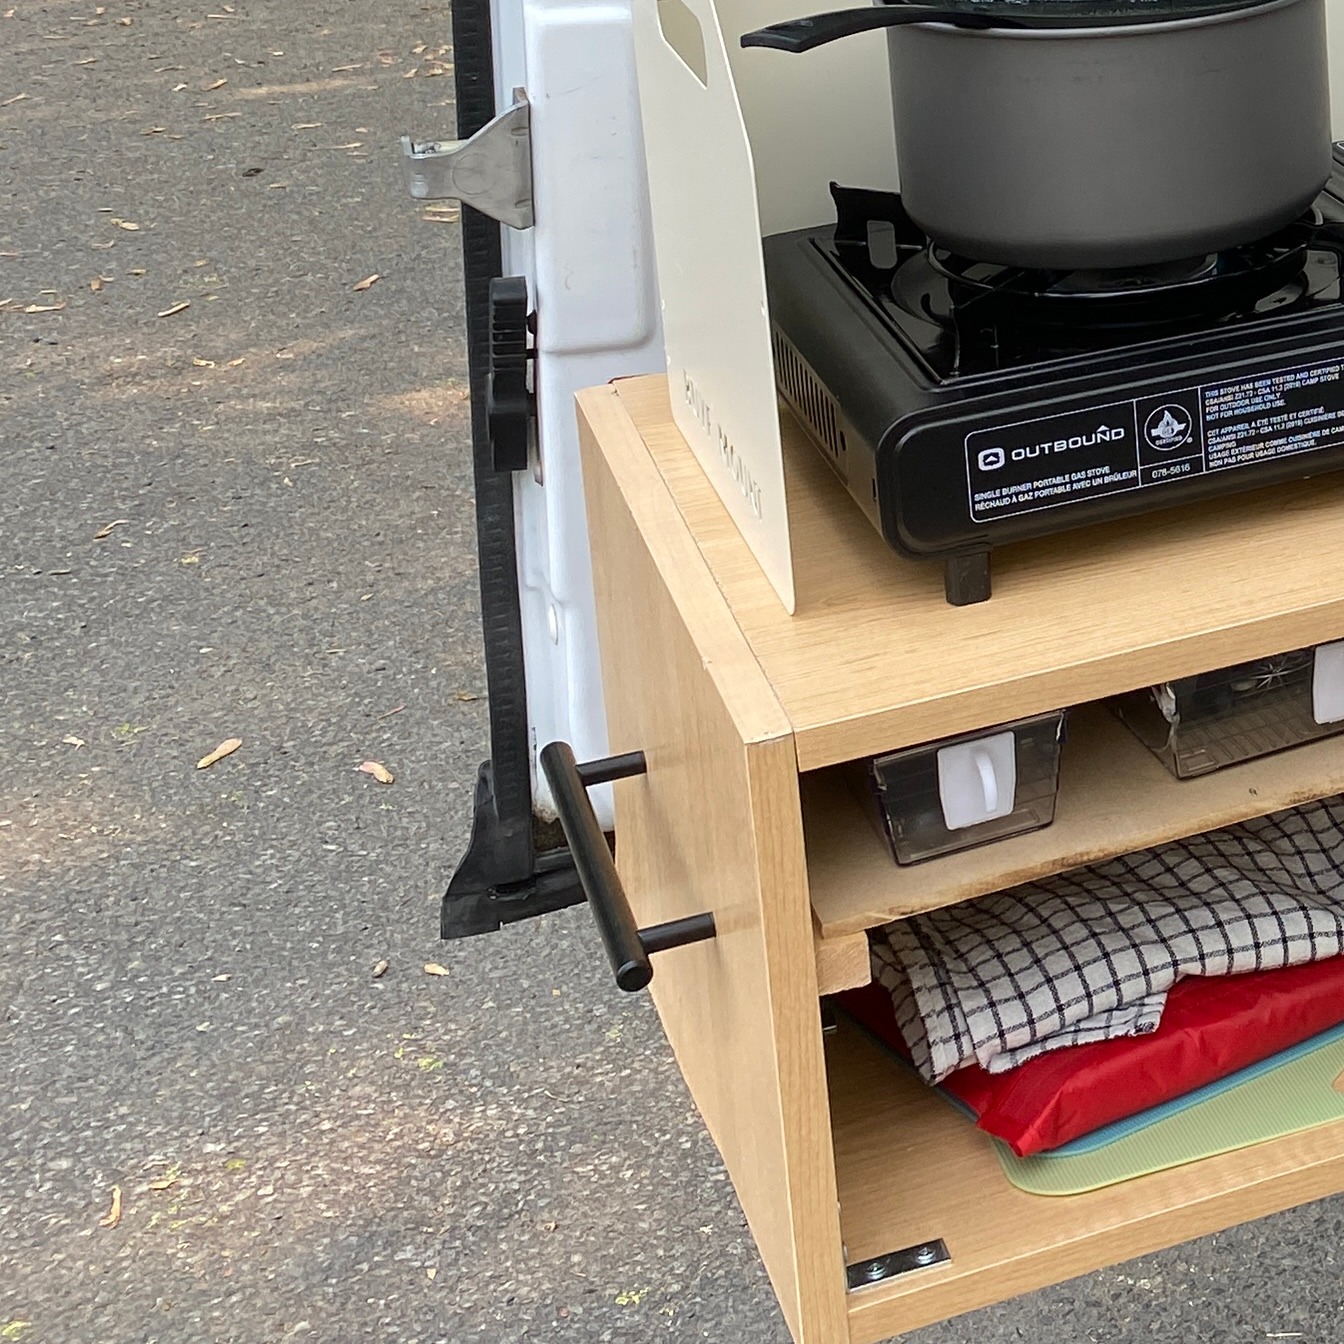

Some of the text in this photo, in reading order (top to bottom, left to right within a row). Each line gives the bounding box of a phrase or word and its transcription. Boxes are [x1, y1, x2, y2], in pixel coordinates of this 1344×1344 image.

[1011, 425, 1125, 460] OUTBOUND
[974, 465, 1110, 501] SINGLE BURNER PORTABLE GAS STOVE
[975, 497, 1011, 511] RÉCHAUD
[1018, 492, 1033, 502] GAZ
[1034, 484, 1071, 498] PORTABLE
[1072, 480, 1091, 490] AVEC
[1092, 477, 1103, 486] UN
